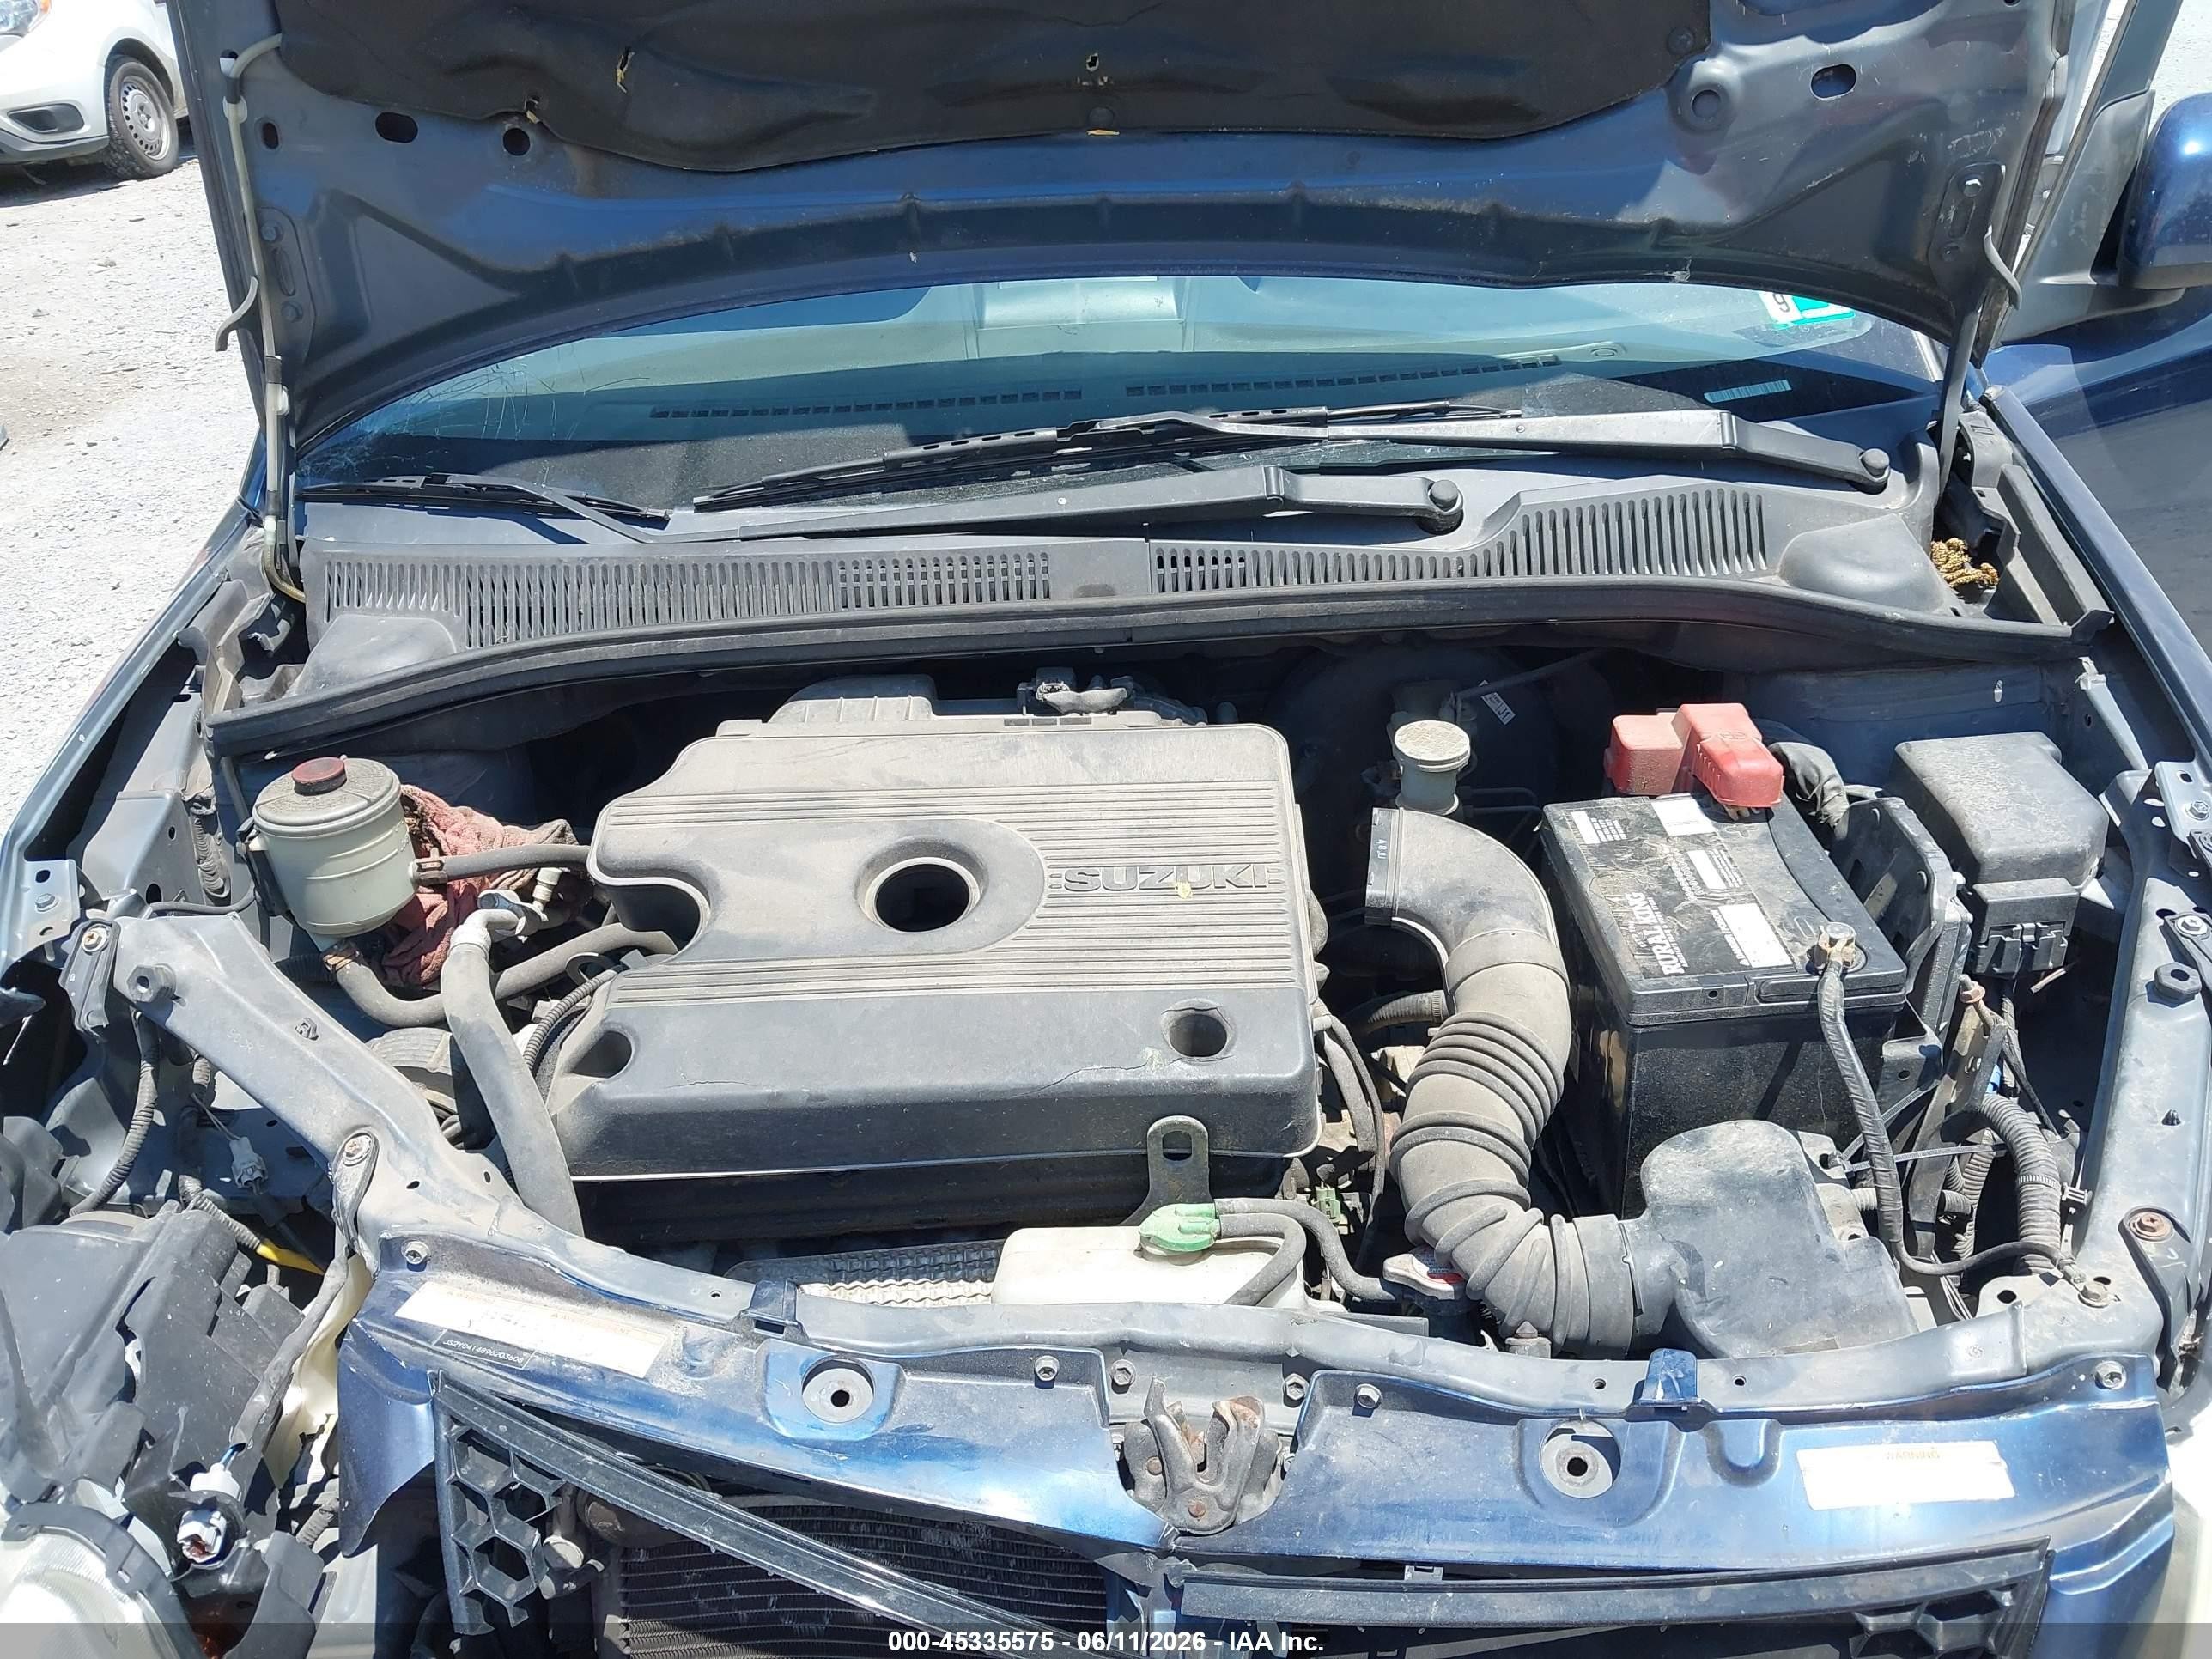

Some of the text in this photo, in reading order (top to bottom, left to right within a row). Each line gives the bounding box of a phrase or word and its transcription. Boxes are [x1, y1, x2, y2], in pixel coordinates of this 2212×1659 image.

[1065, 864, 1267, 891] SUZUKI
[1625, 892, 1658, 925] KING
[1643, 926, 1685, 975] RURAL
